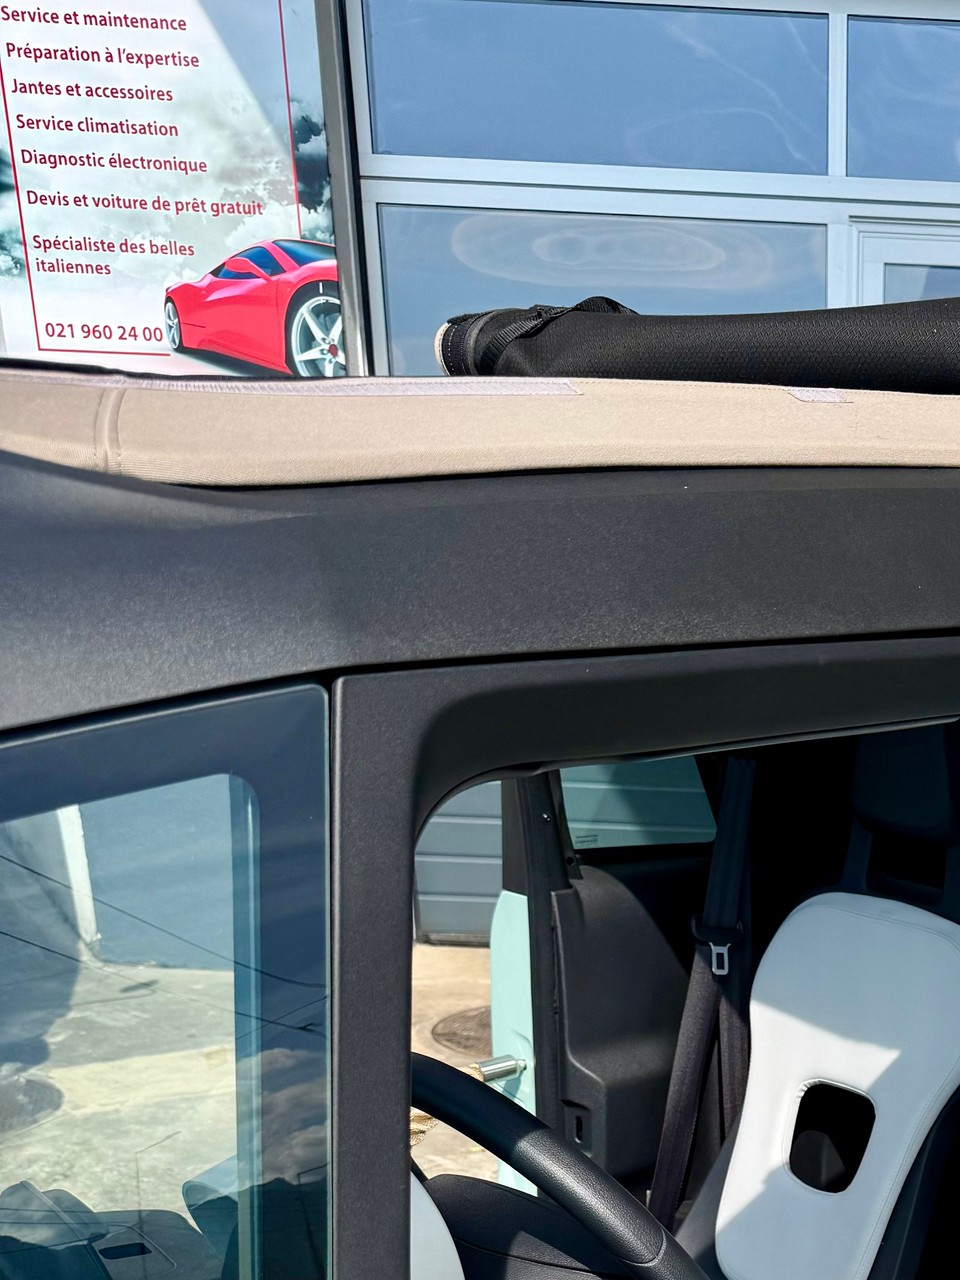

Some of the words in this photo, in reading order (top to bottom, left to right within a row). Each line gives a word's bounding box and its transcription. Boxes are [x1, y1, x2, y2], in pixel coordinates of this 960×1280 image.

[0, 5, 60, 24] Service
[63, 11, 81, 26] et
[83, 14, 187, 31] maintenance
[5, 41, 101, 63] Préparation
[104, 48, 114, 63] à
[11, 79, 63, 96] Jantes
[65, 83, 81, 97] et
[84, 85, 174, 102] accessoires
[15, 113, 73, 132] Service
[77, 117, 179, 137] climatisation
[20, 148, 105, 170] Diagnostic
[108, 153, 207, 176] électronique
[25, 189, 70, 207] Devis
[72, 194, 88, 207] et
[92, 196, 148, 211] voiture
[150, 196, 171, 212] de
[174, 200, 206, 216] prêt
[209, 201, 263, 218] gratuit
[31, 234, 116, 254] Spécialiste
[118, 239, 146, 254] des
[149, 240, 195, 257] belles
[35, 259, 111, 276] italiennes
[44, 322, 75, 339] 021
[80, 323, 113, 341] 960
[117, 325, 139, 341] 24
[141, 326, 164, 343] 00
